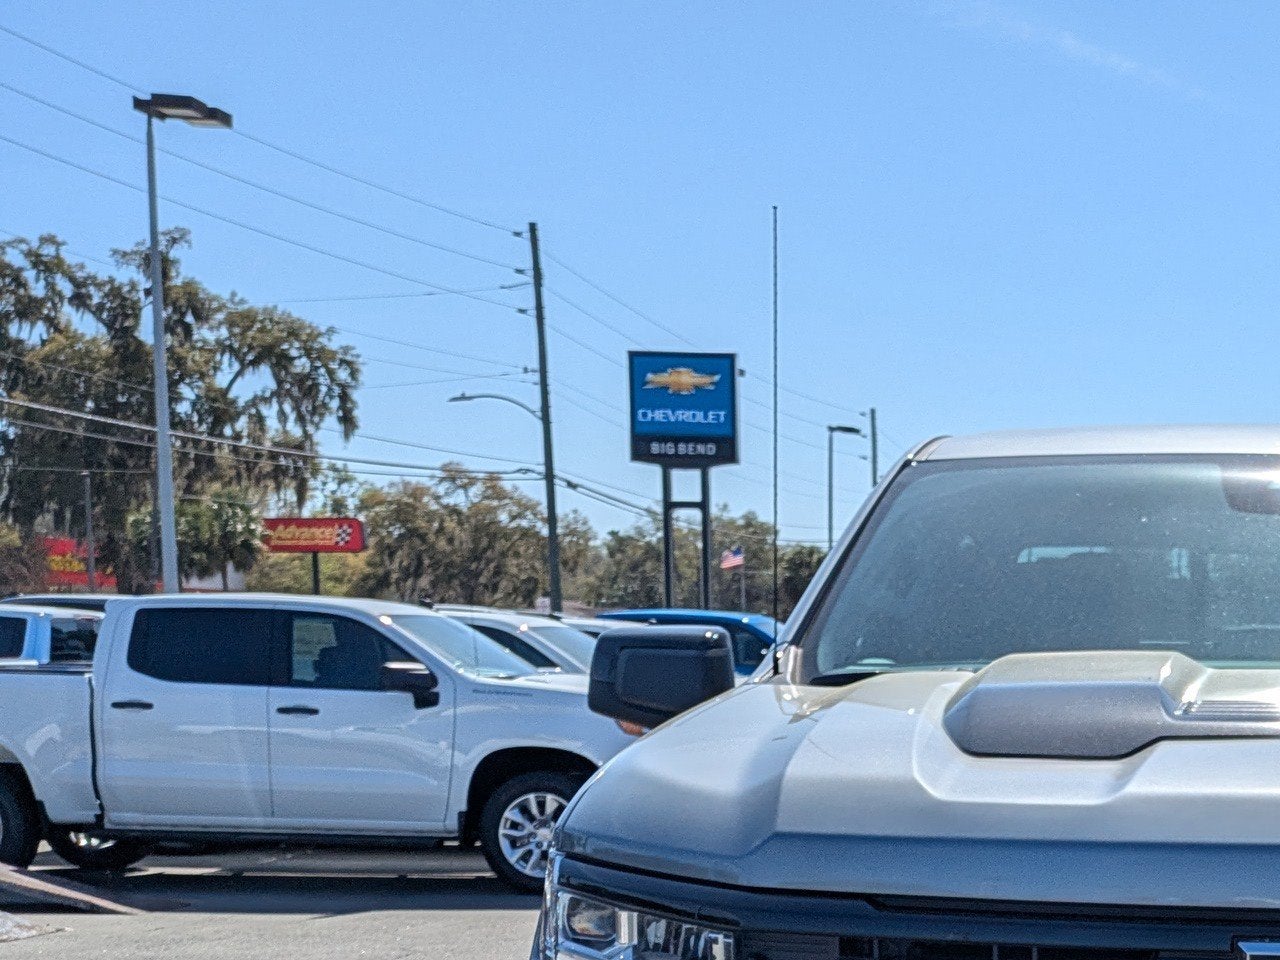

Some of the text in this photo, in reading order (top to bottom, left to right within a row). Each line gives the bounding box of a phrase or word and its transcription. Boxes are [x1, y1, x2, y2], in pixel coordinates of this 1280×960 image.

[637, 408, 727, 423] CHEVROLET
[649, 441, 716, 455] BIG BEND
